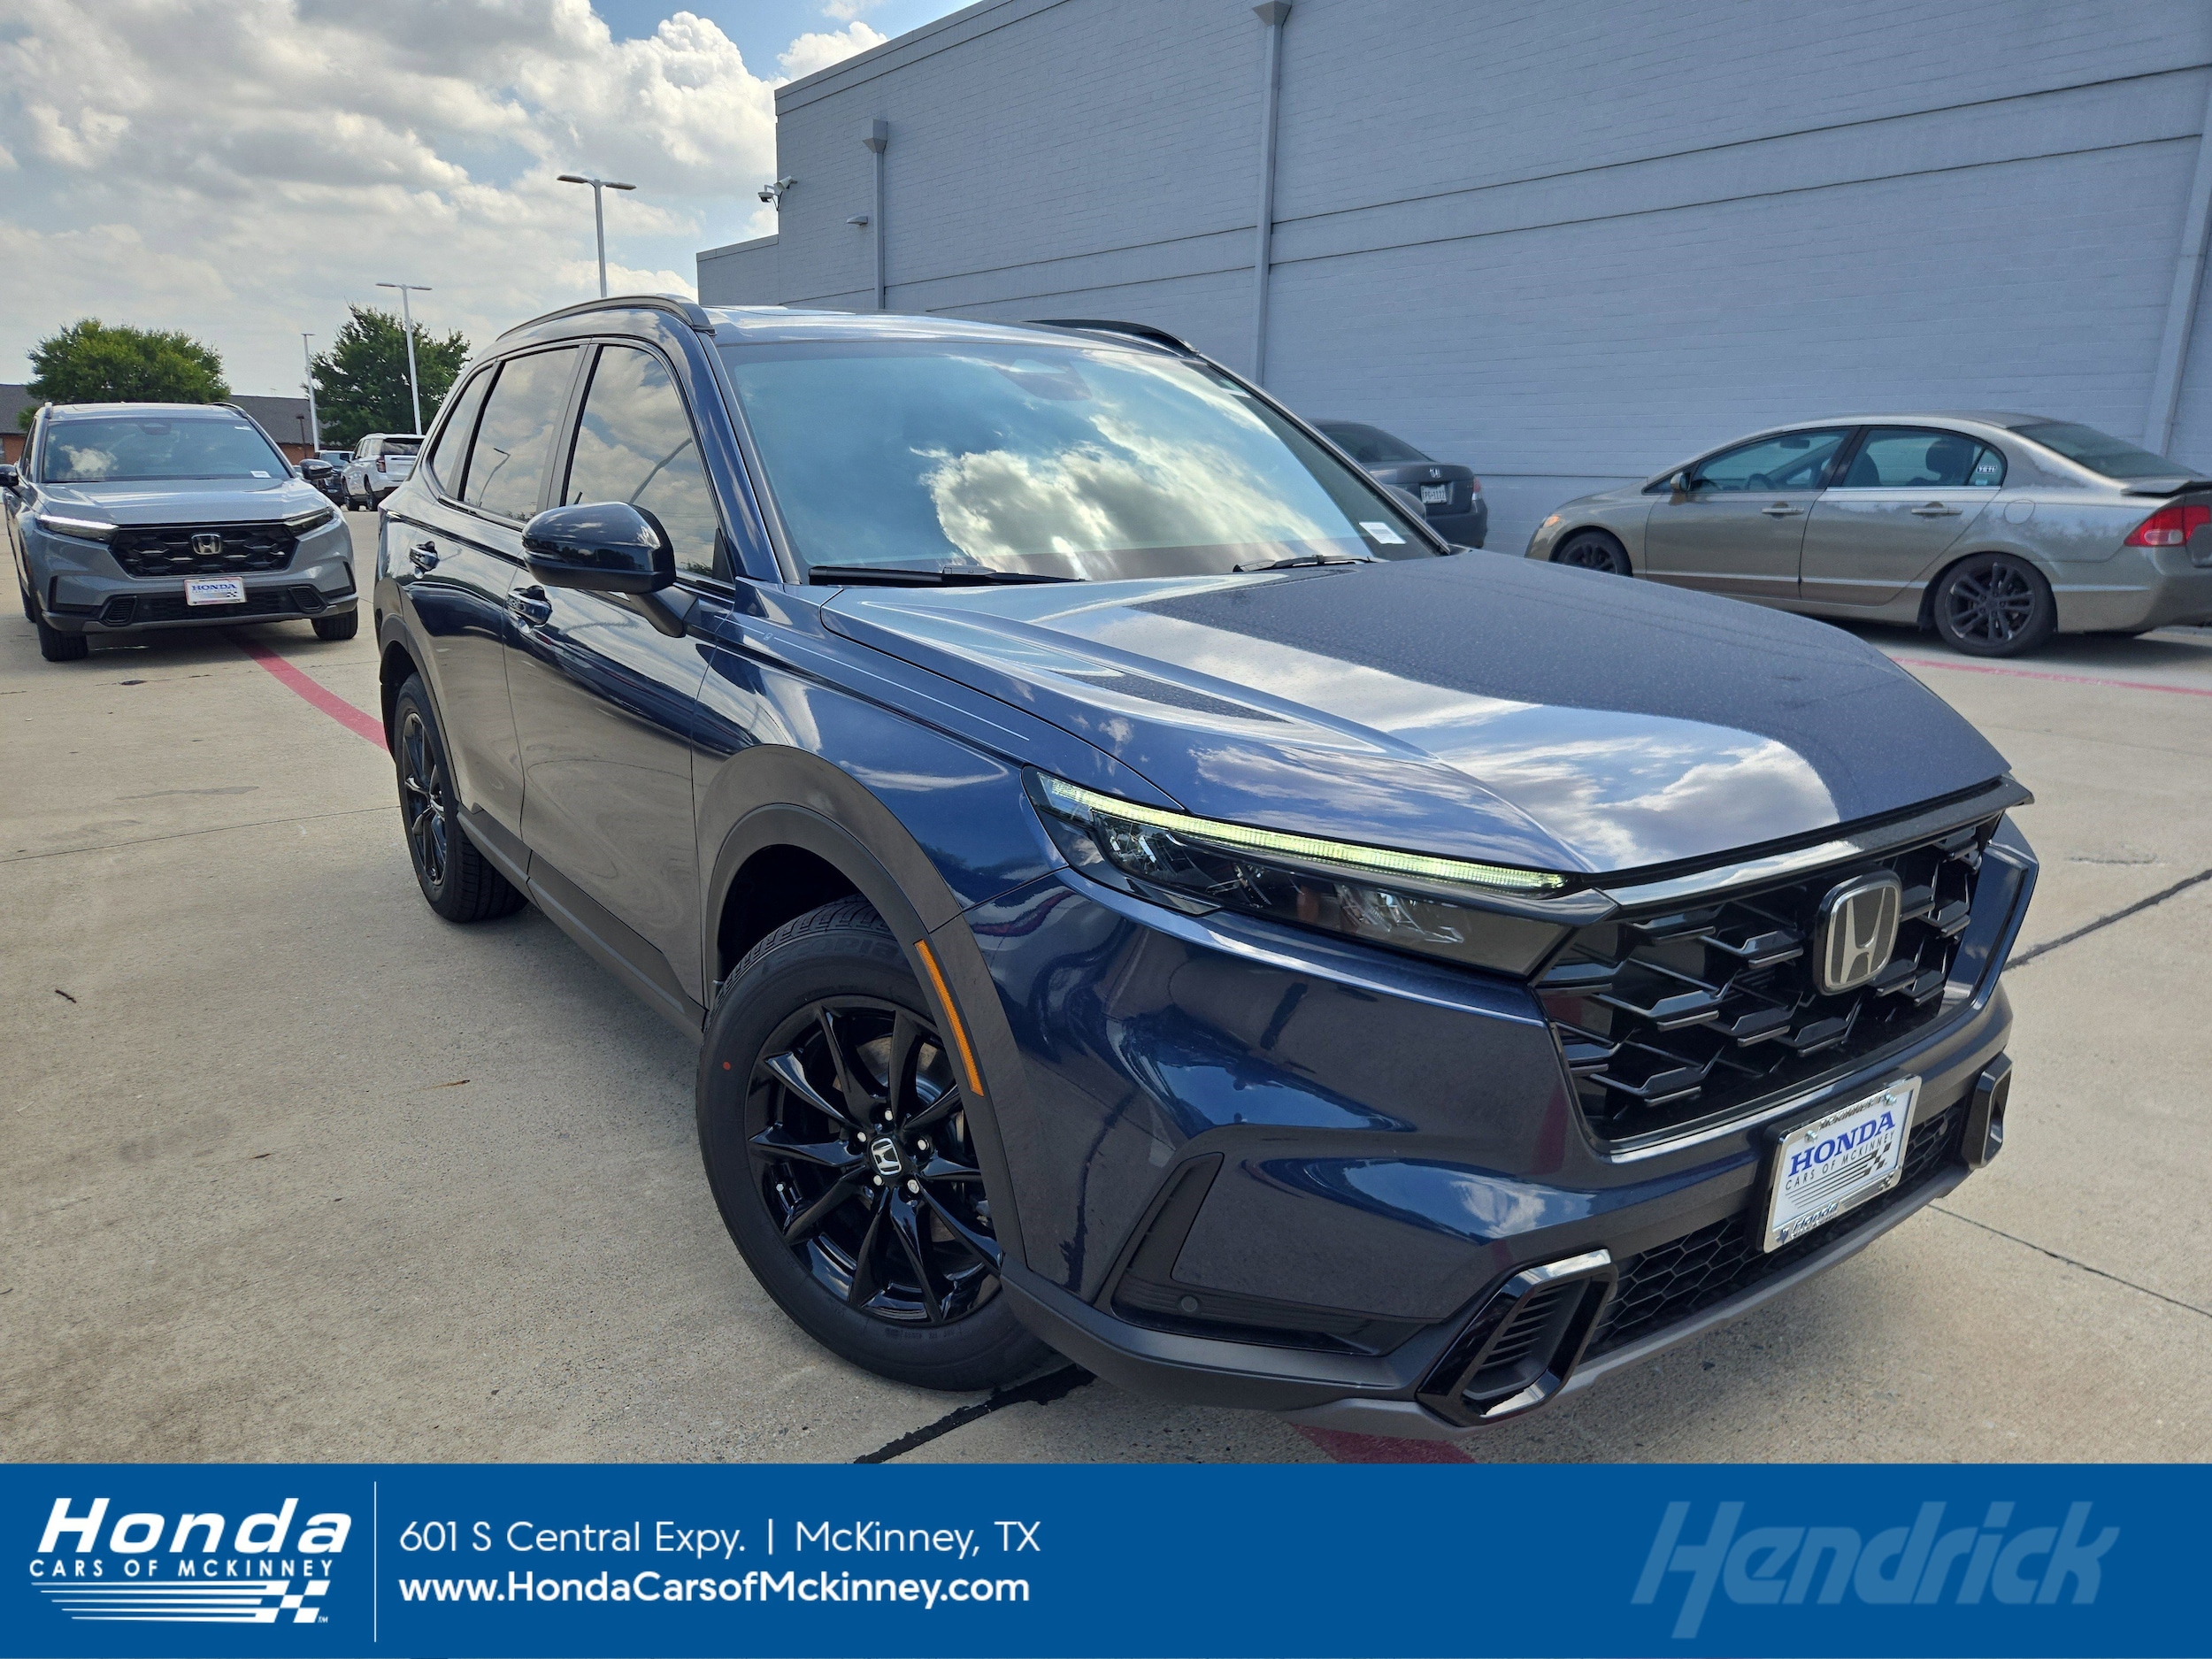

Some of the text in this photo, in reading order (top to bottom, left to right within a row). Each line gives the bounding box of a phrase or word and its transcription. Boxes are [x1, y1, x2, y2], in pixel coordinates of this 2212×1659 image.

[1786, 1131, 1894, 1191] CARS OF MCKINNEY
[1787, 1110, 1895, 1178] HONDA
